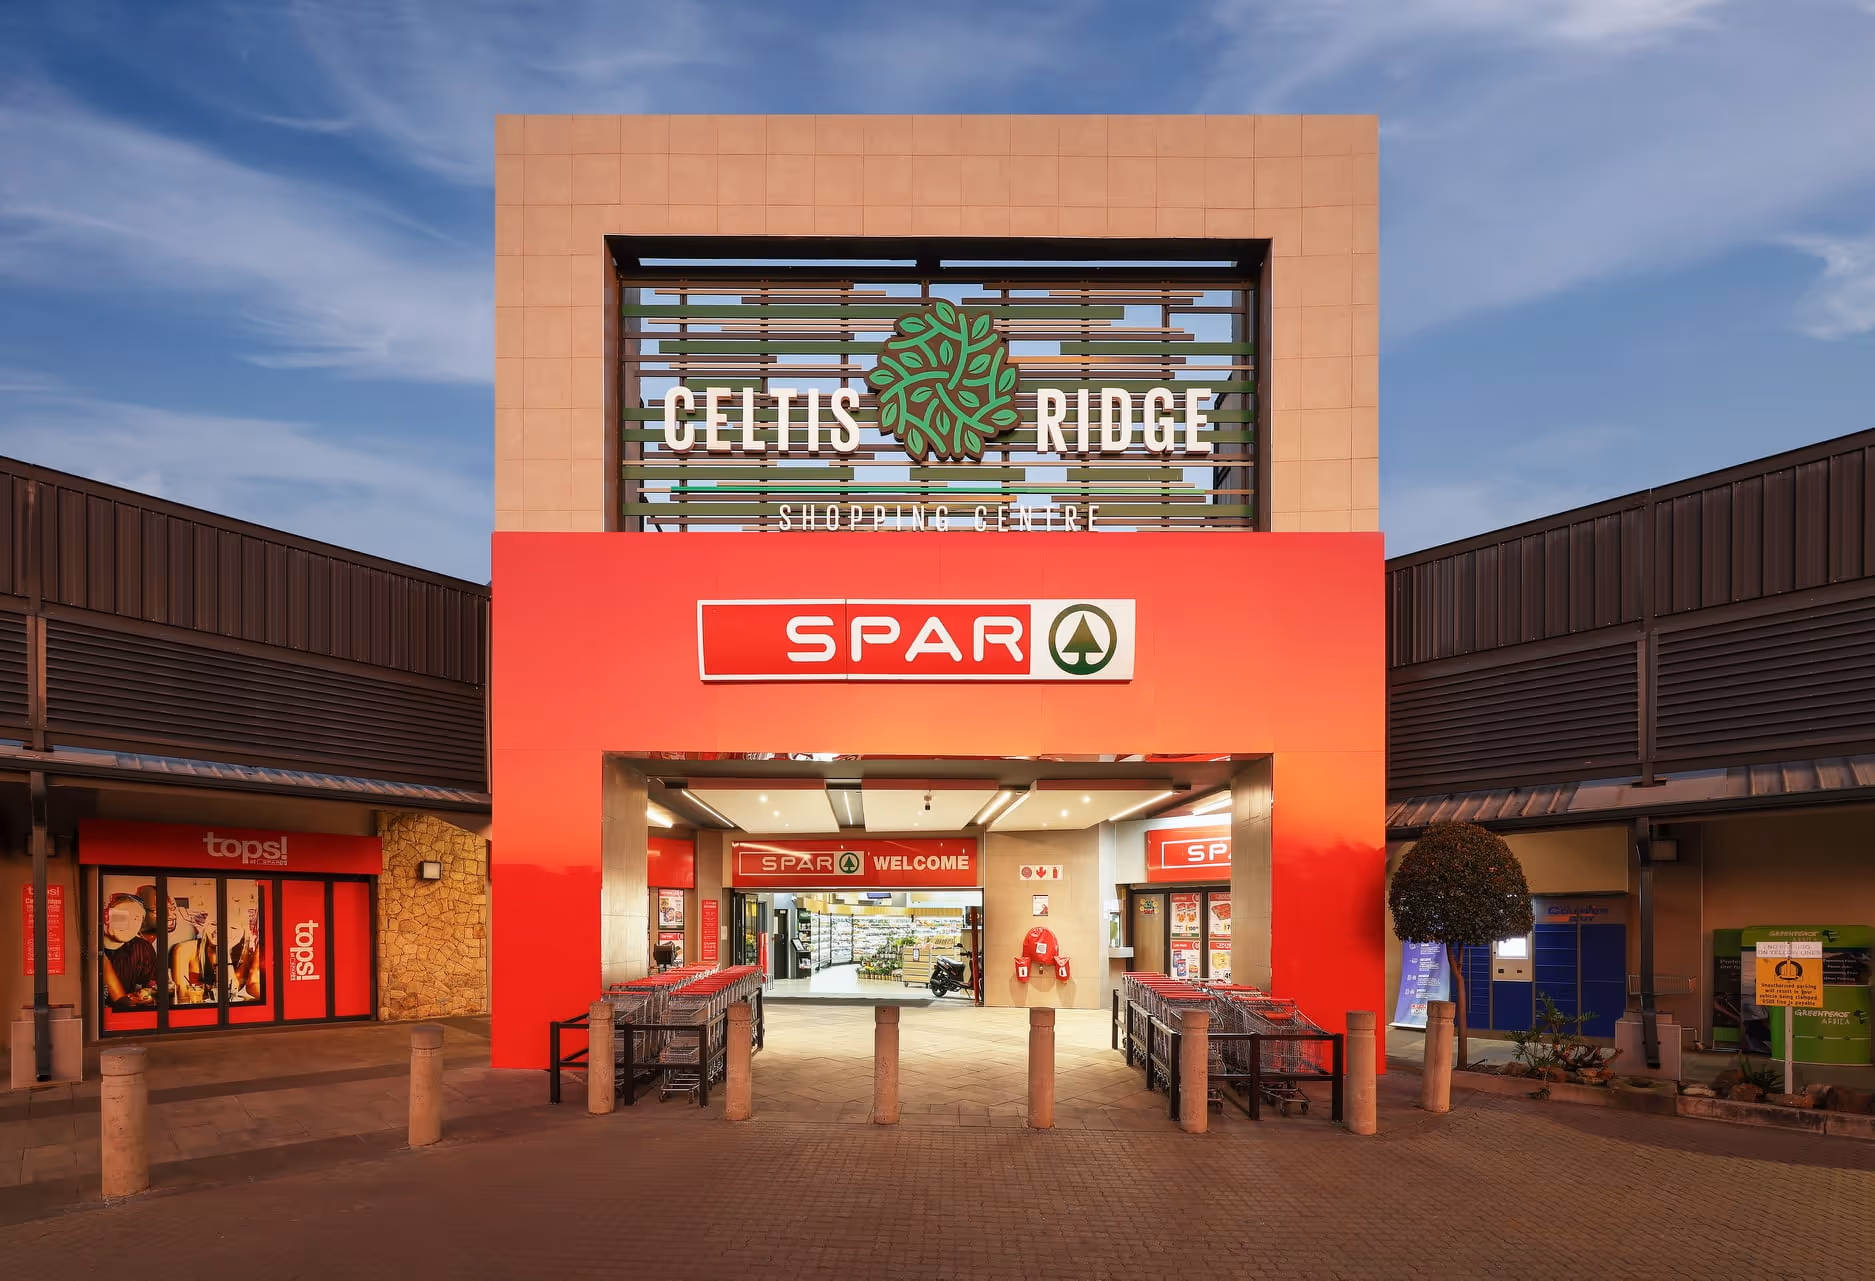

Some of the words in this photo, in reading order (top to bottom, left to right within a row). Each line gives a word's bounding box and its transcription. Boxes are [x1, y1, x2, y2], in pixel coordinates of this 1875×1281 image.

[664, 385, 860, 454] CELTIS
[1037, 387, 1212, 455] RIDGE
[779, 504, 949, 532] SHOPPING
[974, 505, 1101, 532] CENTRE
[786, 616, 1024, 662] SPAR
[203, 831, 288, 864] tops!
[1187, 843, 1231, 862] SP
[762, 856, 832, 871] SPAR
[873, 855, 969, 871] WELCOME
[290, 920, 320, 980] tops!
[1794, 1008, 1850, 1018] GREENPEACE
